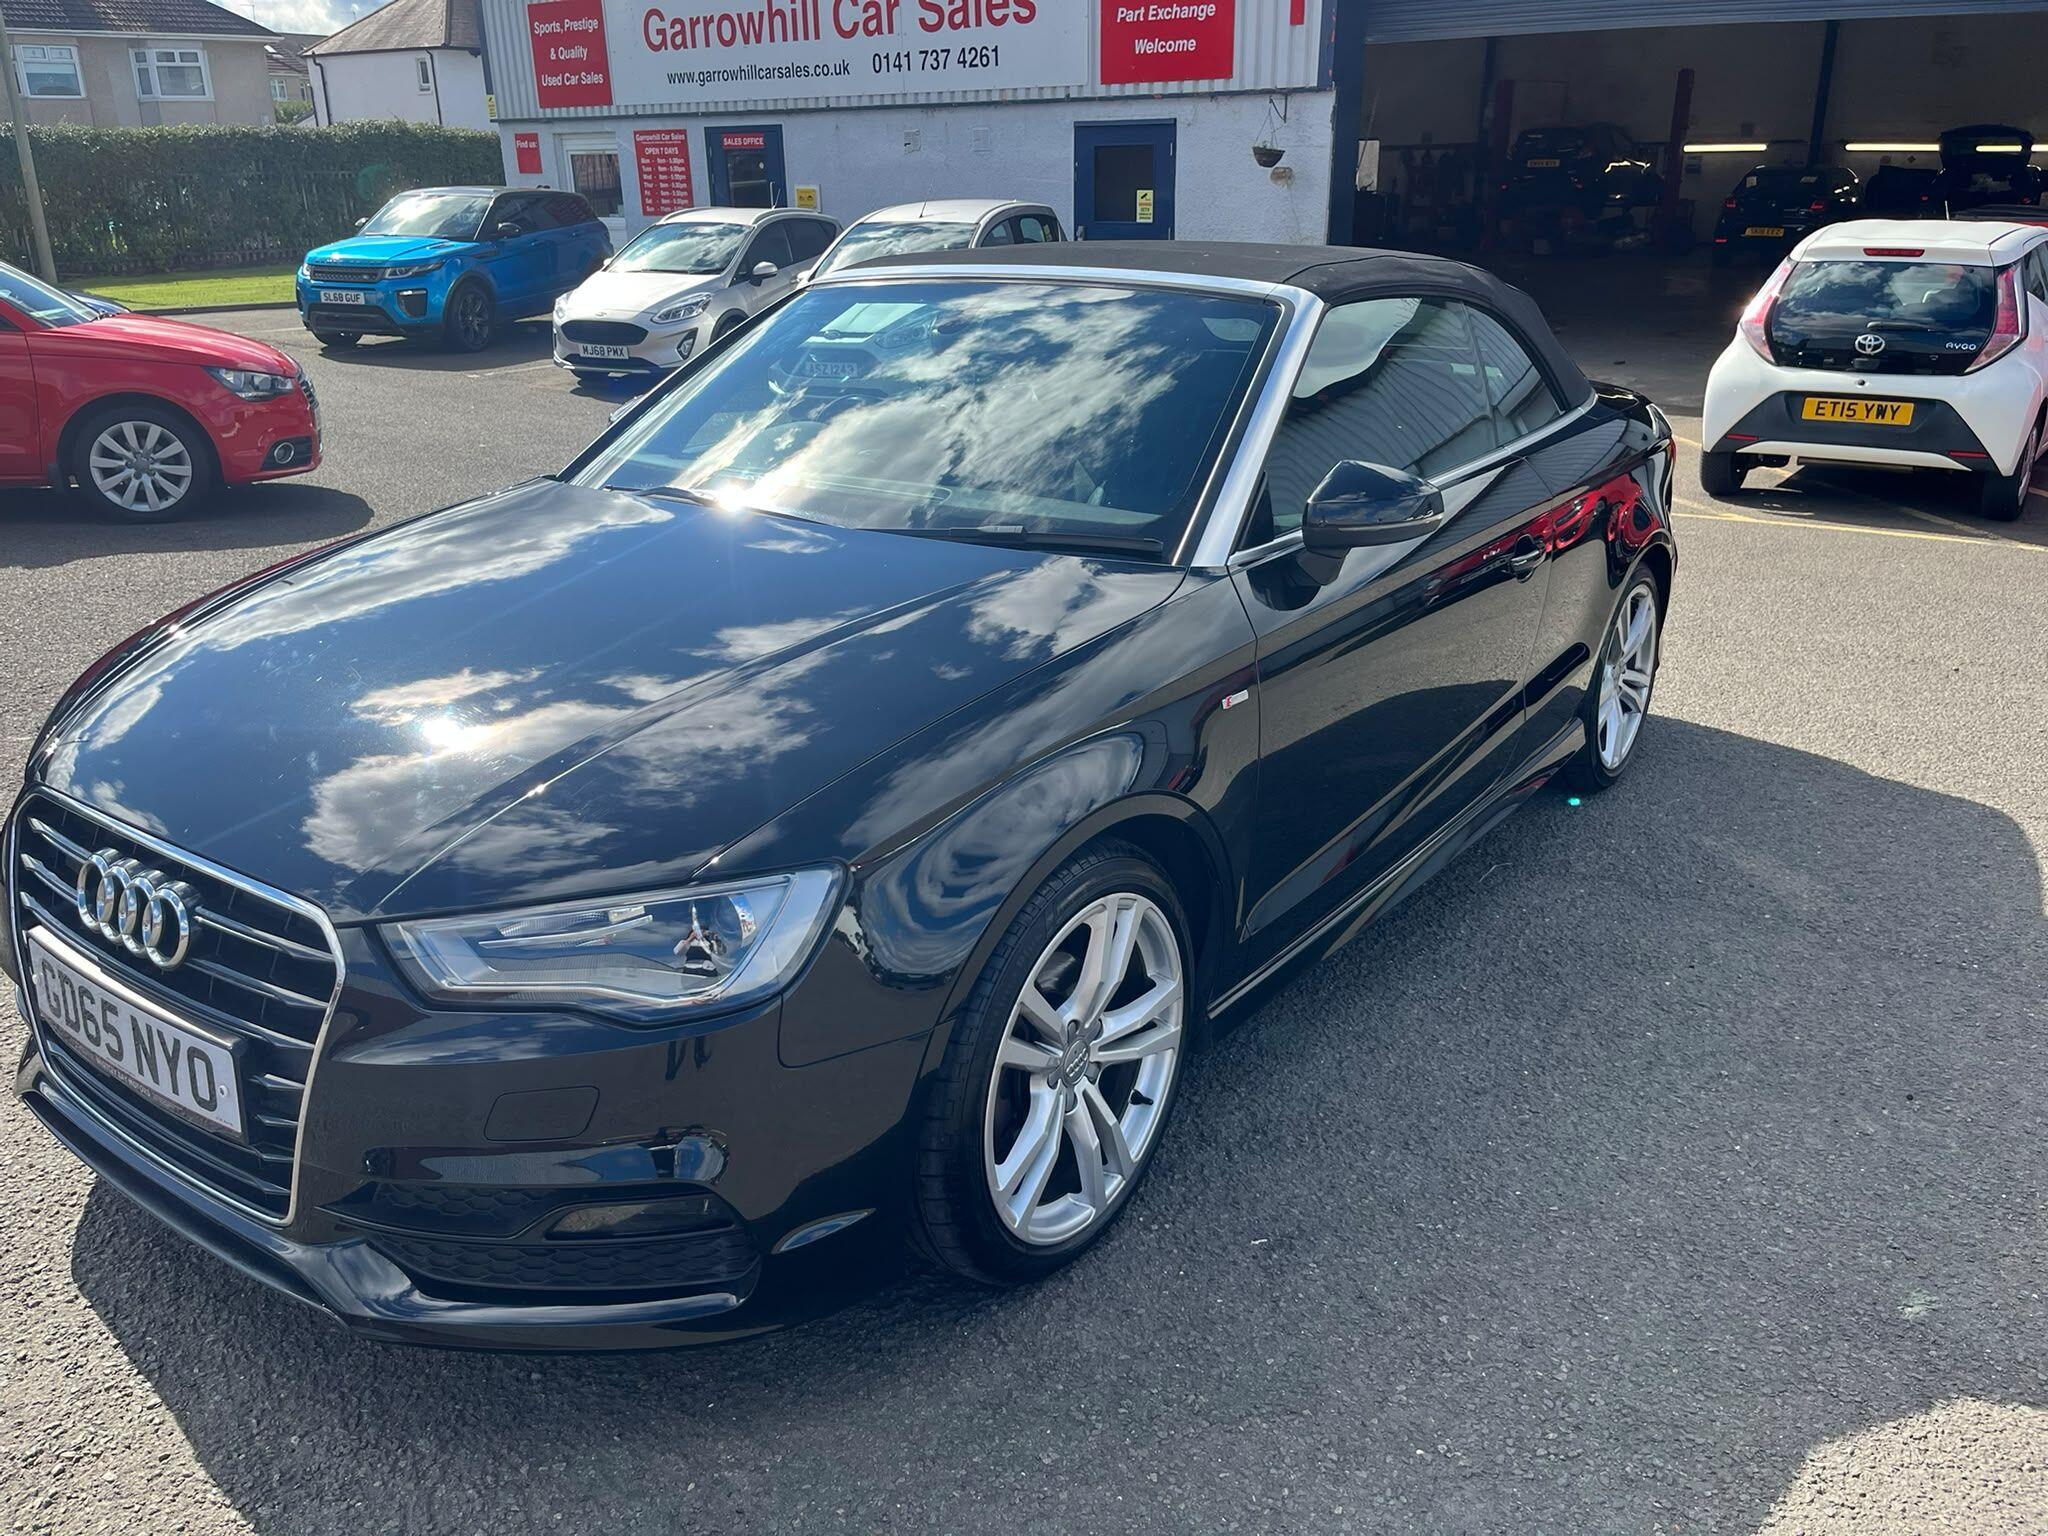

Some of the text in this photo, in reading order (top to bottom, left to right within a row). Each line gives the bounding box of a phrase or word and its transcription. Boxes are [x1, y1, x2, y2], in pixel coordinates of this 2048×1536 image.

[1117, 3, 1216, 23] Part Exchange
[534, 17, 599, 36] Sports, Prestige
[643, 0, 1036, 52] Garrowhill Car Sales
[550, 45, 588, 61] & Quality
[1134, 37, 1196, 54] Welcome
[872, 45, 1000, 73] 0141 737 4261
[541, 72, 604, 86] Used Car Sales
[667, 59, 850, 86] www.garrowhillcarsales.co.uk
[516, 140, 528, 148] Find
[723, 137, 764, 146] SALES OFFICE
[645, 147, 659, 155] OPEN
[664, 147, 679, 155] DAYS
[323, 292, 361, 303] SL68 GUF
[583, 345, 605, 356] MJ68
[1946, 342, 1976, 350] AYGO
[1815, 401, 1901, 420] ET15 YWY
[41, 960, 217, 1113] GD65 NYO
